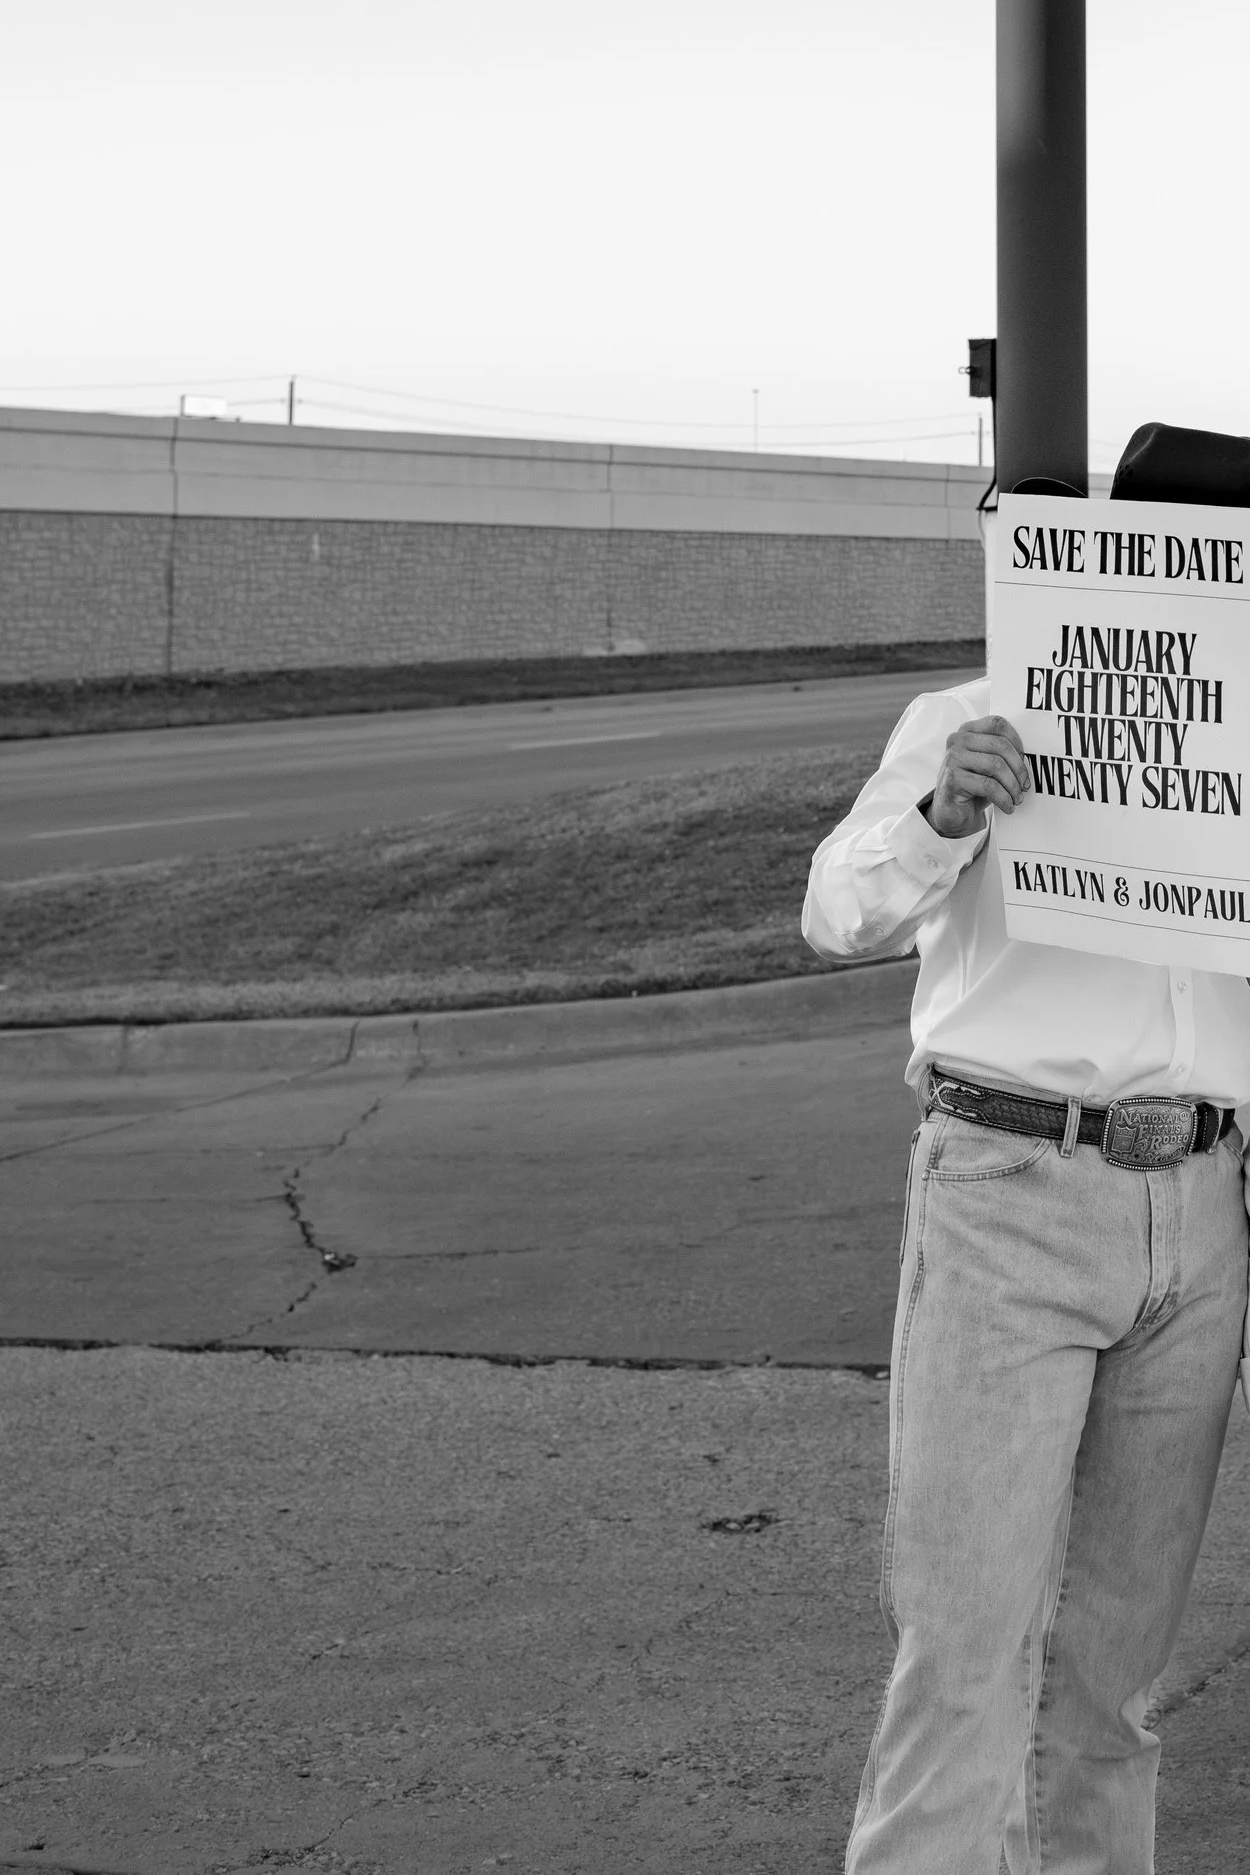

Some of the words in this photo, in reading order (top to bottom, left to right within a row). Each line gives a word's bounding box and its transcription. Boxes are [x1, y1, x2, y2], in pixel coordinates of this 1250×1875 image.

[1013, 526, 1085, 572] SAVE
[1094, 531, 1155, 578] THE
[1164, 536, 1243, 583] DATE
[1052, 625, 1197, 675] JANUARY
[1025, 667, 1223, 723] EIGHTEENTH
[1058, 715, 1188, 765] TWENTY
[1024, 753, 1133, 806] WENTY
[1142, 766, 1241, 816] SEVEN
[1013, 861, 1105, 903] KATLYN
[1114, 877, 1130, 906] &
[1117, 1109, 1178, 1125] NATIONAL
[1139, 1124, 1181, 1136] FINALS
[1150, 1134, 1189, 1150] RODEO
